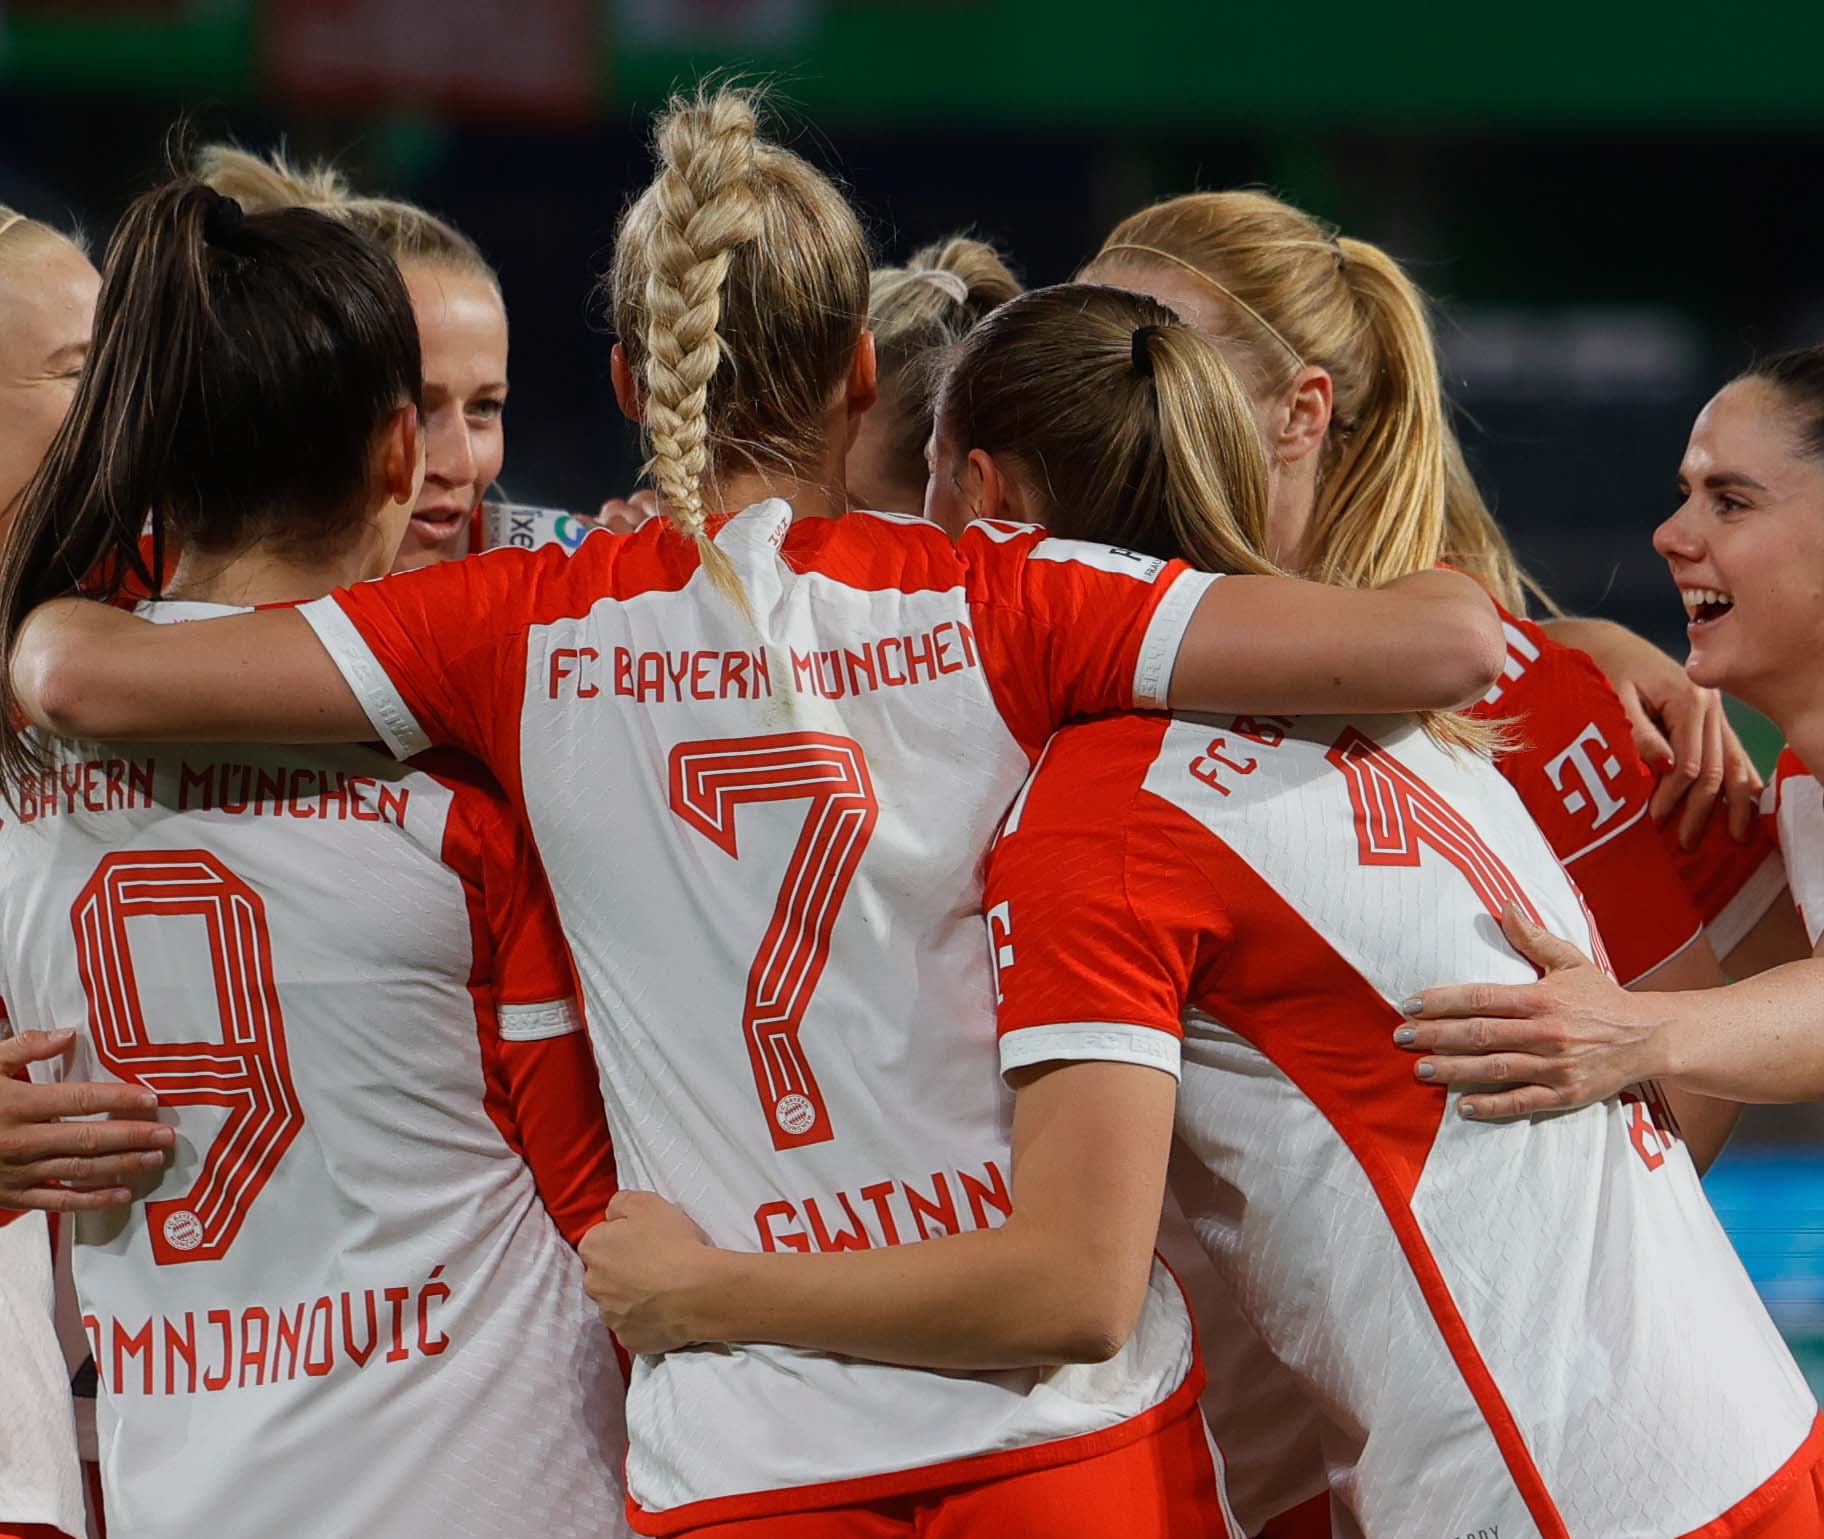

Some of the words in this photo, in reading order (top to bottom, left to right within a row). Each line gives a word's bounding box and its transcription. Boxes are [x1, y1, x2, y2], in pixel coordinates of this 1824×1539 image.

[510, 510, 543, 549] ixe
[549, 646, 599, 699] FC
[613, 645, 772, 703] BAYERN
[789, 620, 974, 700] MÜNCHEN
[18, 758, 156, 825] BAYERN
[178, 760, 408, 830] MÜNCHEN
[1189, 737, 1258, 797] FC
[668, 731, 879, 1151] 7
[69, 848, 305, 1266] 9
[754, 1161, 1013, 1253] GWINN
